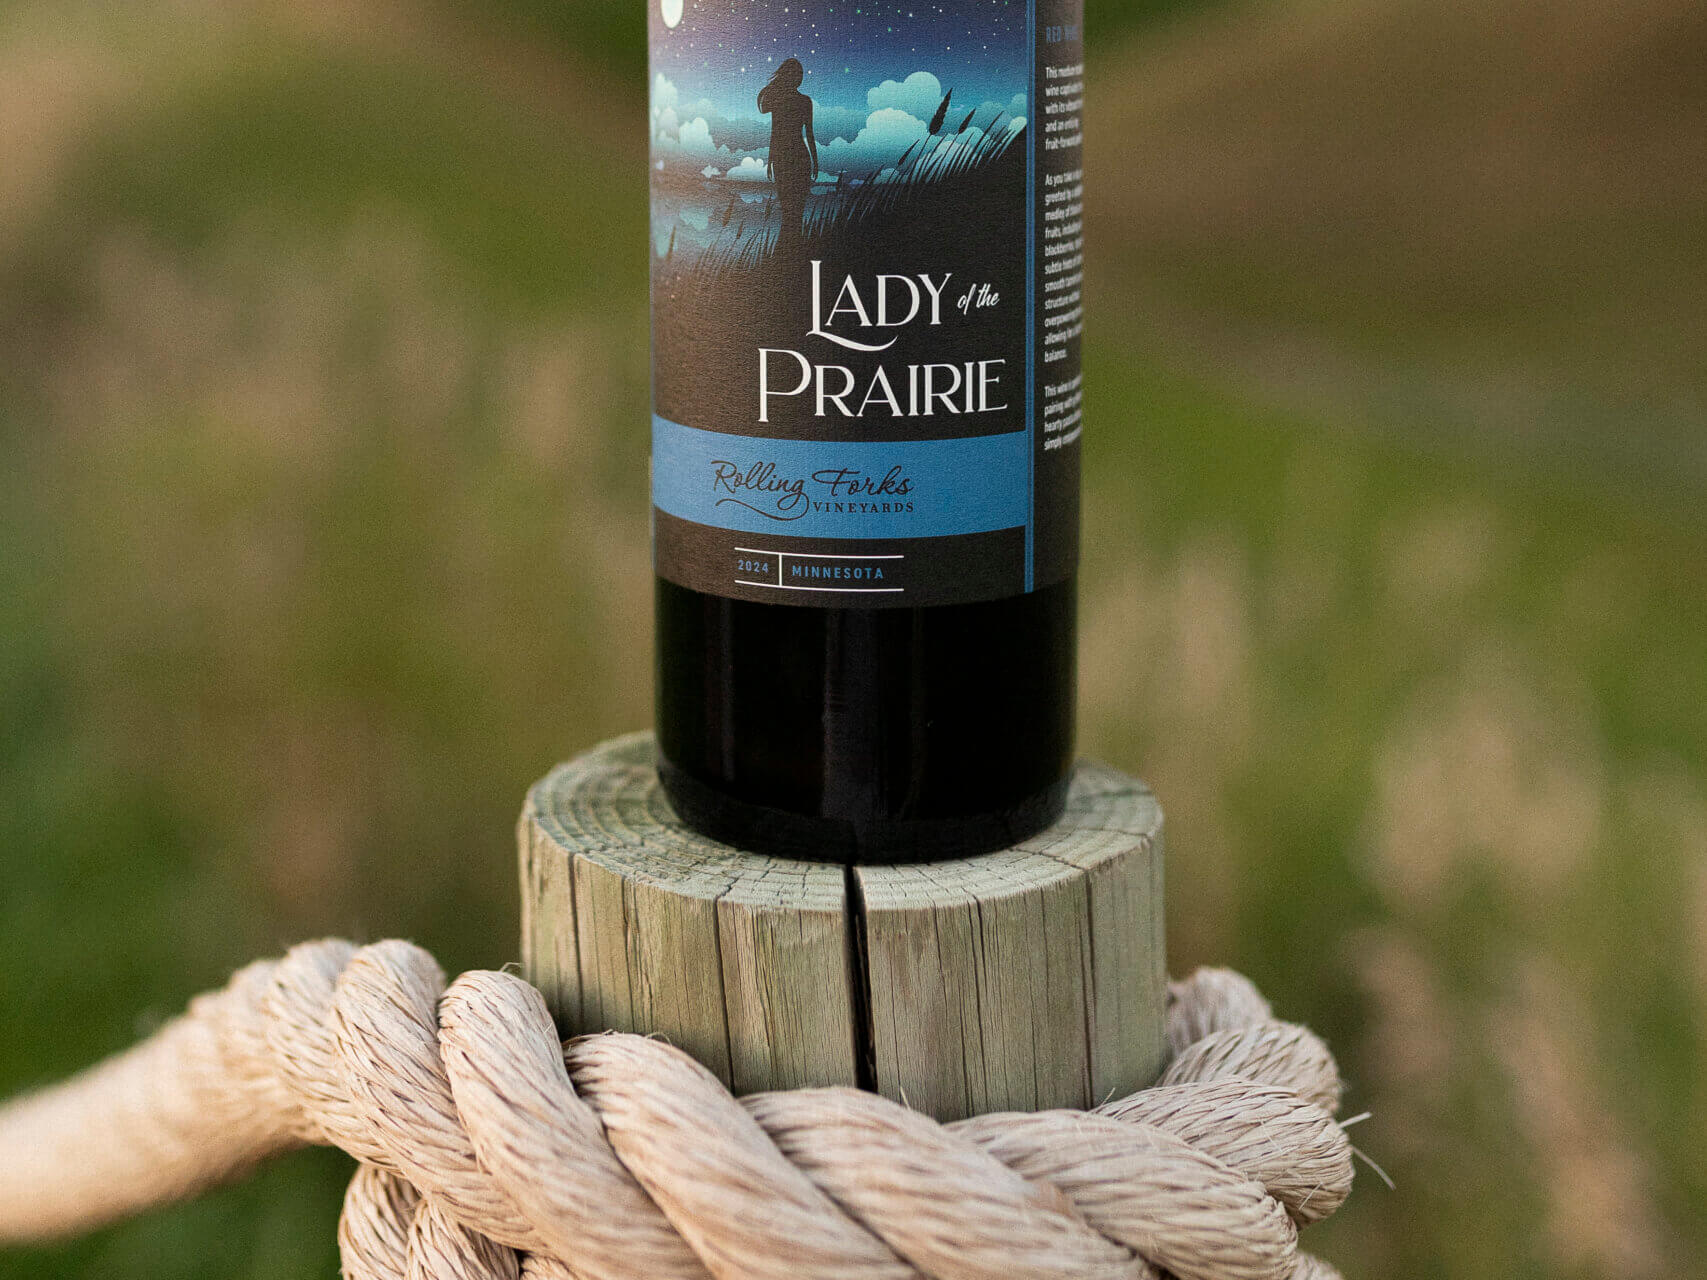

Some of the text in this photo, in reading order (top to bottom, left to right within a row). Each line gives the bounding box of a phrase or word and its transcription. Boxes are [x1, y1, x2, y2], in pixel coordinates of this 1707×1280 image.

[1045, 66, 1057, 79] This
[806, 260, 1000, 351] LADY of the
[758, 348, 1008, 422] PRAIRIE
[711, 460, 914, 521] Rolling Forks
[813, 501, 914, 513] VINEYARDS
[737, 559, 884, 579] 2024 MINNESOTA
